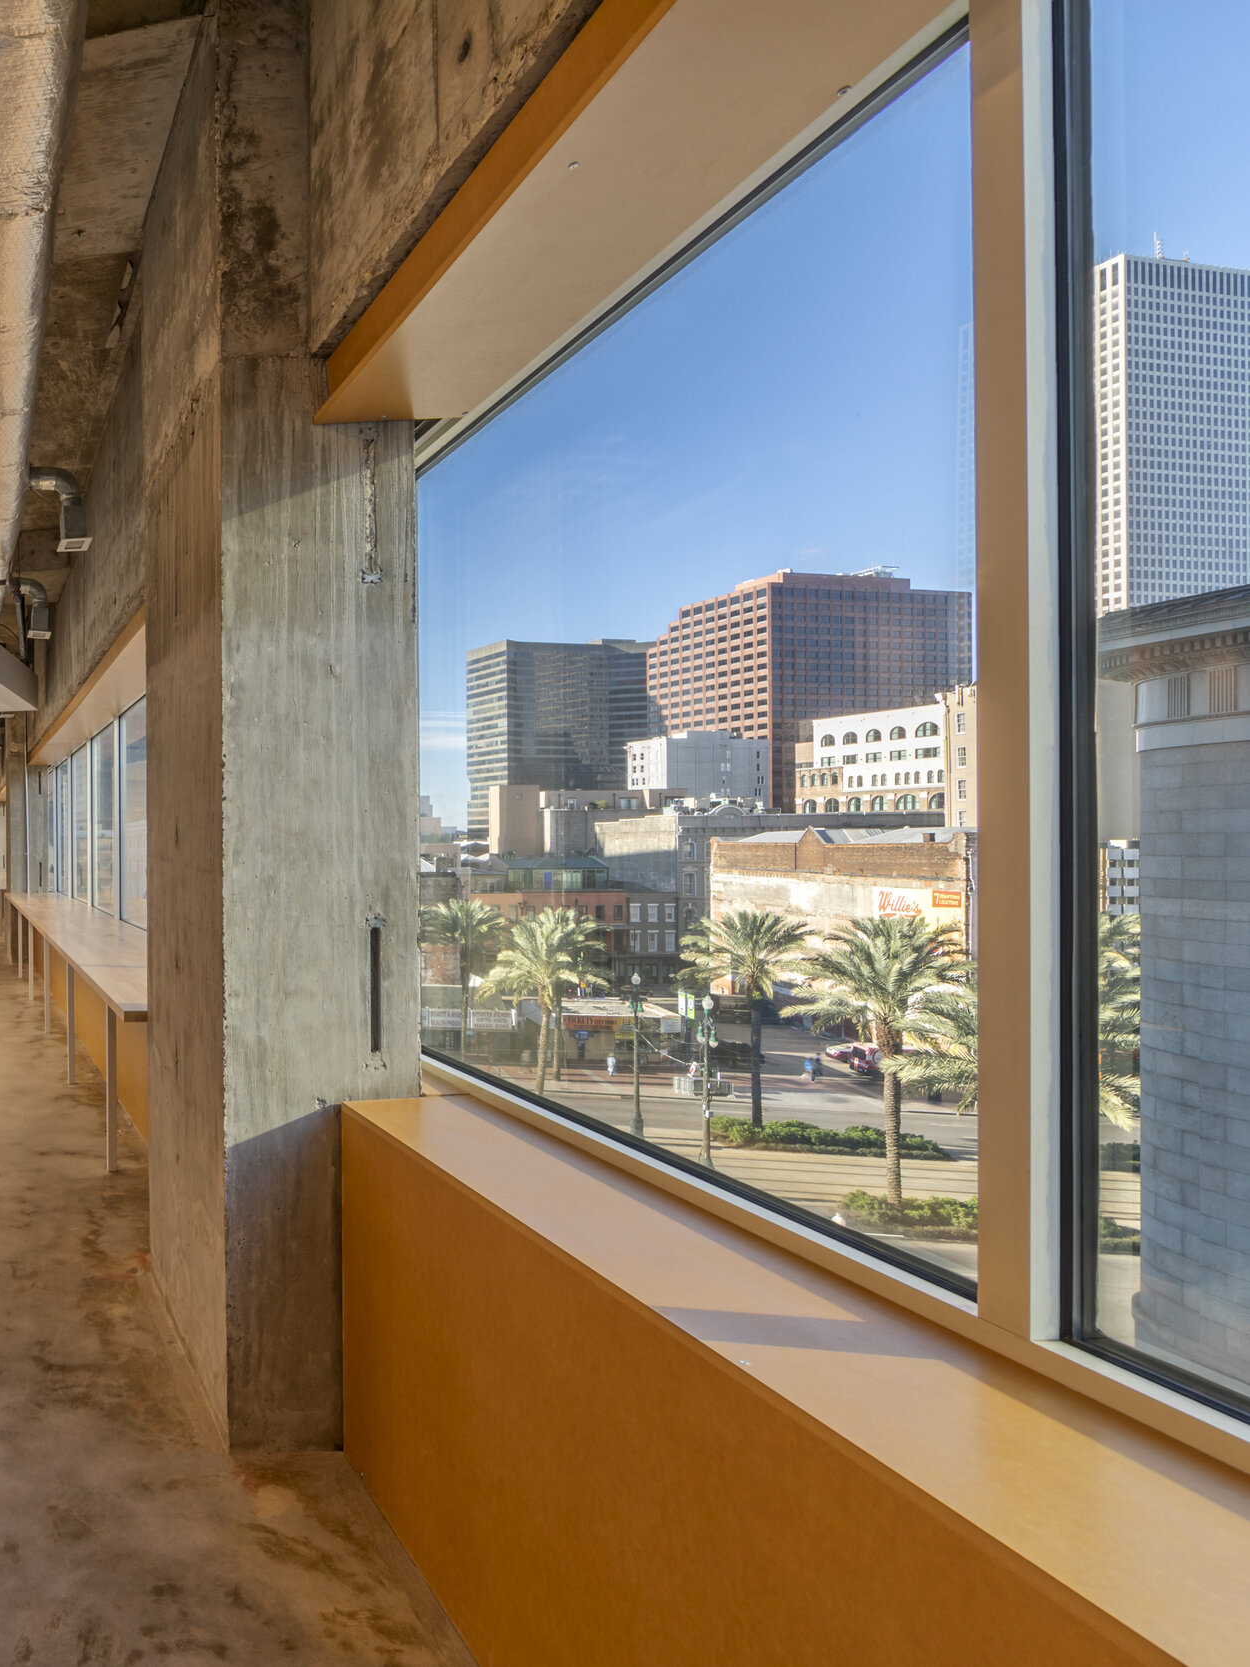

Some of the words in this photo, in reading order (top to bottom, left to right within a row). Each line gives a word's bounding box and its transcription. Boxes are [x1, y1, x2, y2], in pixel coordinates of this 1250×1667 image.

[878, 890, 923, 914] Willie's
[934, 893, 940, 905] 7
[567, 1015, 593, 1024] TICKETS
